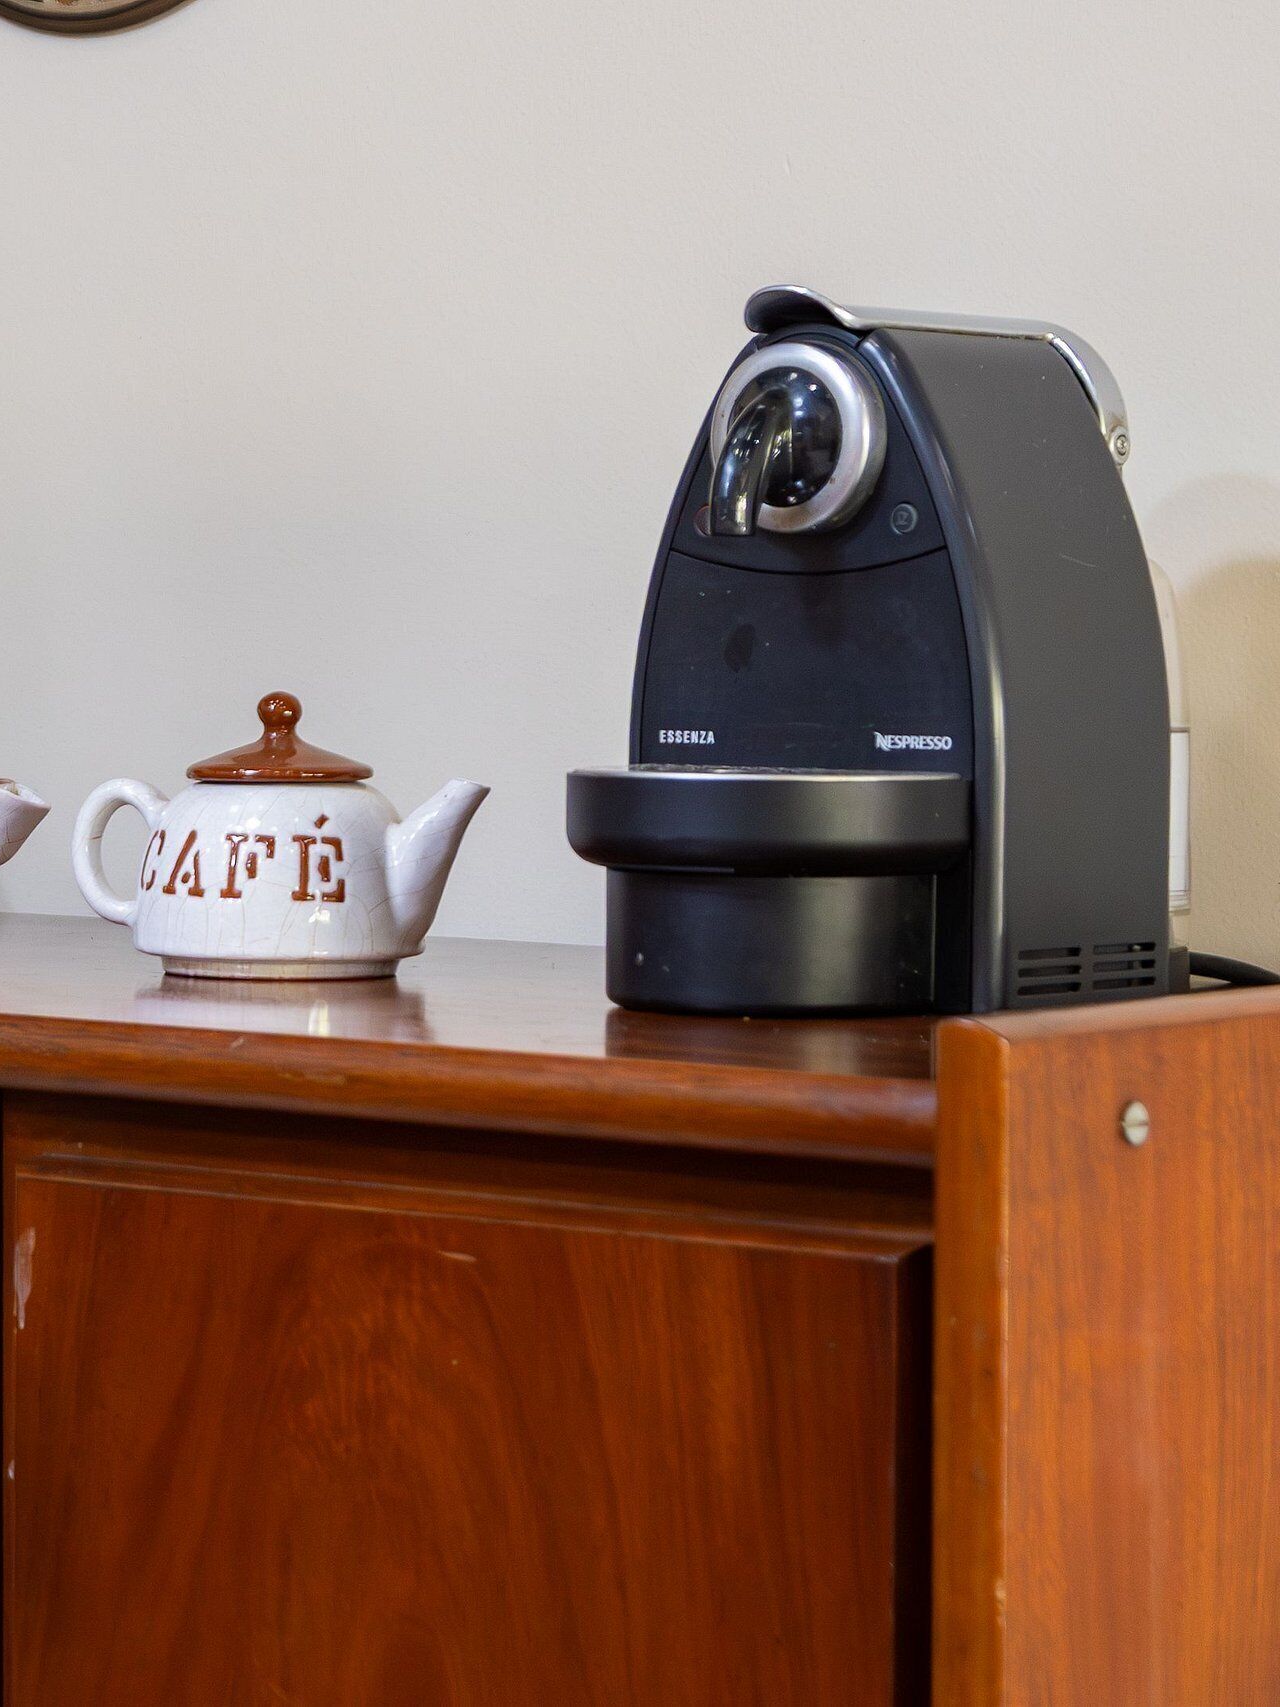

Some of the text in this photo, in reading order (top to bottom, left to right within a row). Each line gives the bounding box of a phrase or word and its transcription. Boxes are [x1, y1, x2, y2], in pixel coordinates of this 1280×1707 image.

[659, 729, 715, 744] ESSENZA
[874, 731, 953, 751] NESPRESSO
[140, 813, 346, 903] CAFÉ
